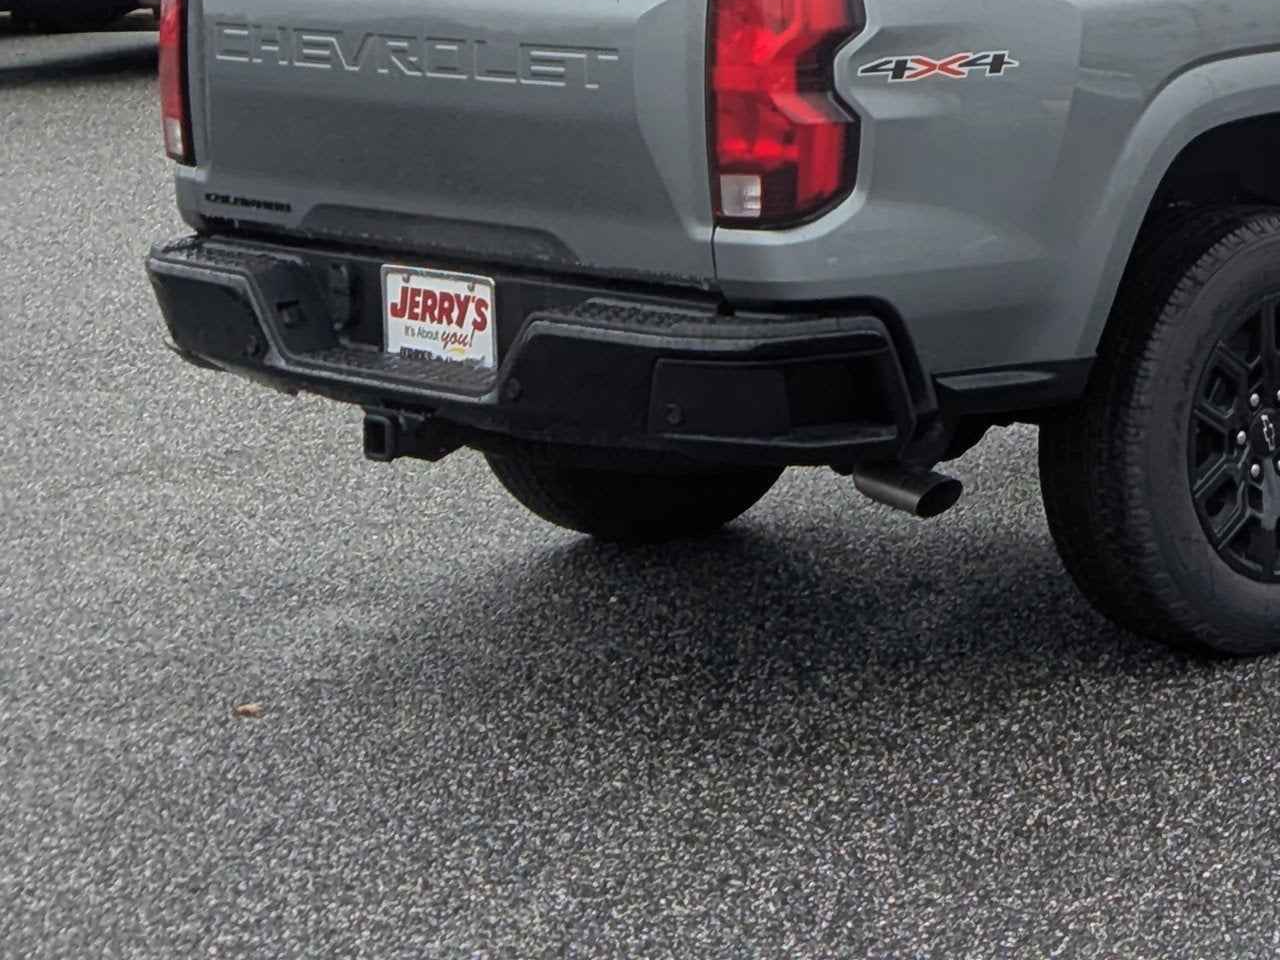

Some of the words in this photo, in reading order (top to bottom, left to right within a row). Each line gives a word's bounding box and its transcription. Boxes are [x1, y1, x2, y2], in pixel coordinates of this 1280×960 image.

[214, 22, 620, 90] CHEVROLET
[390, 285, 489, 332] JERRY'S
[440, 327, 475, 350] you!
